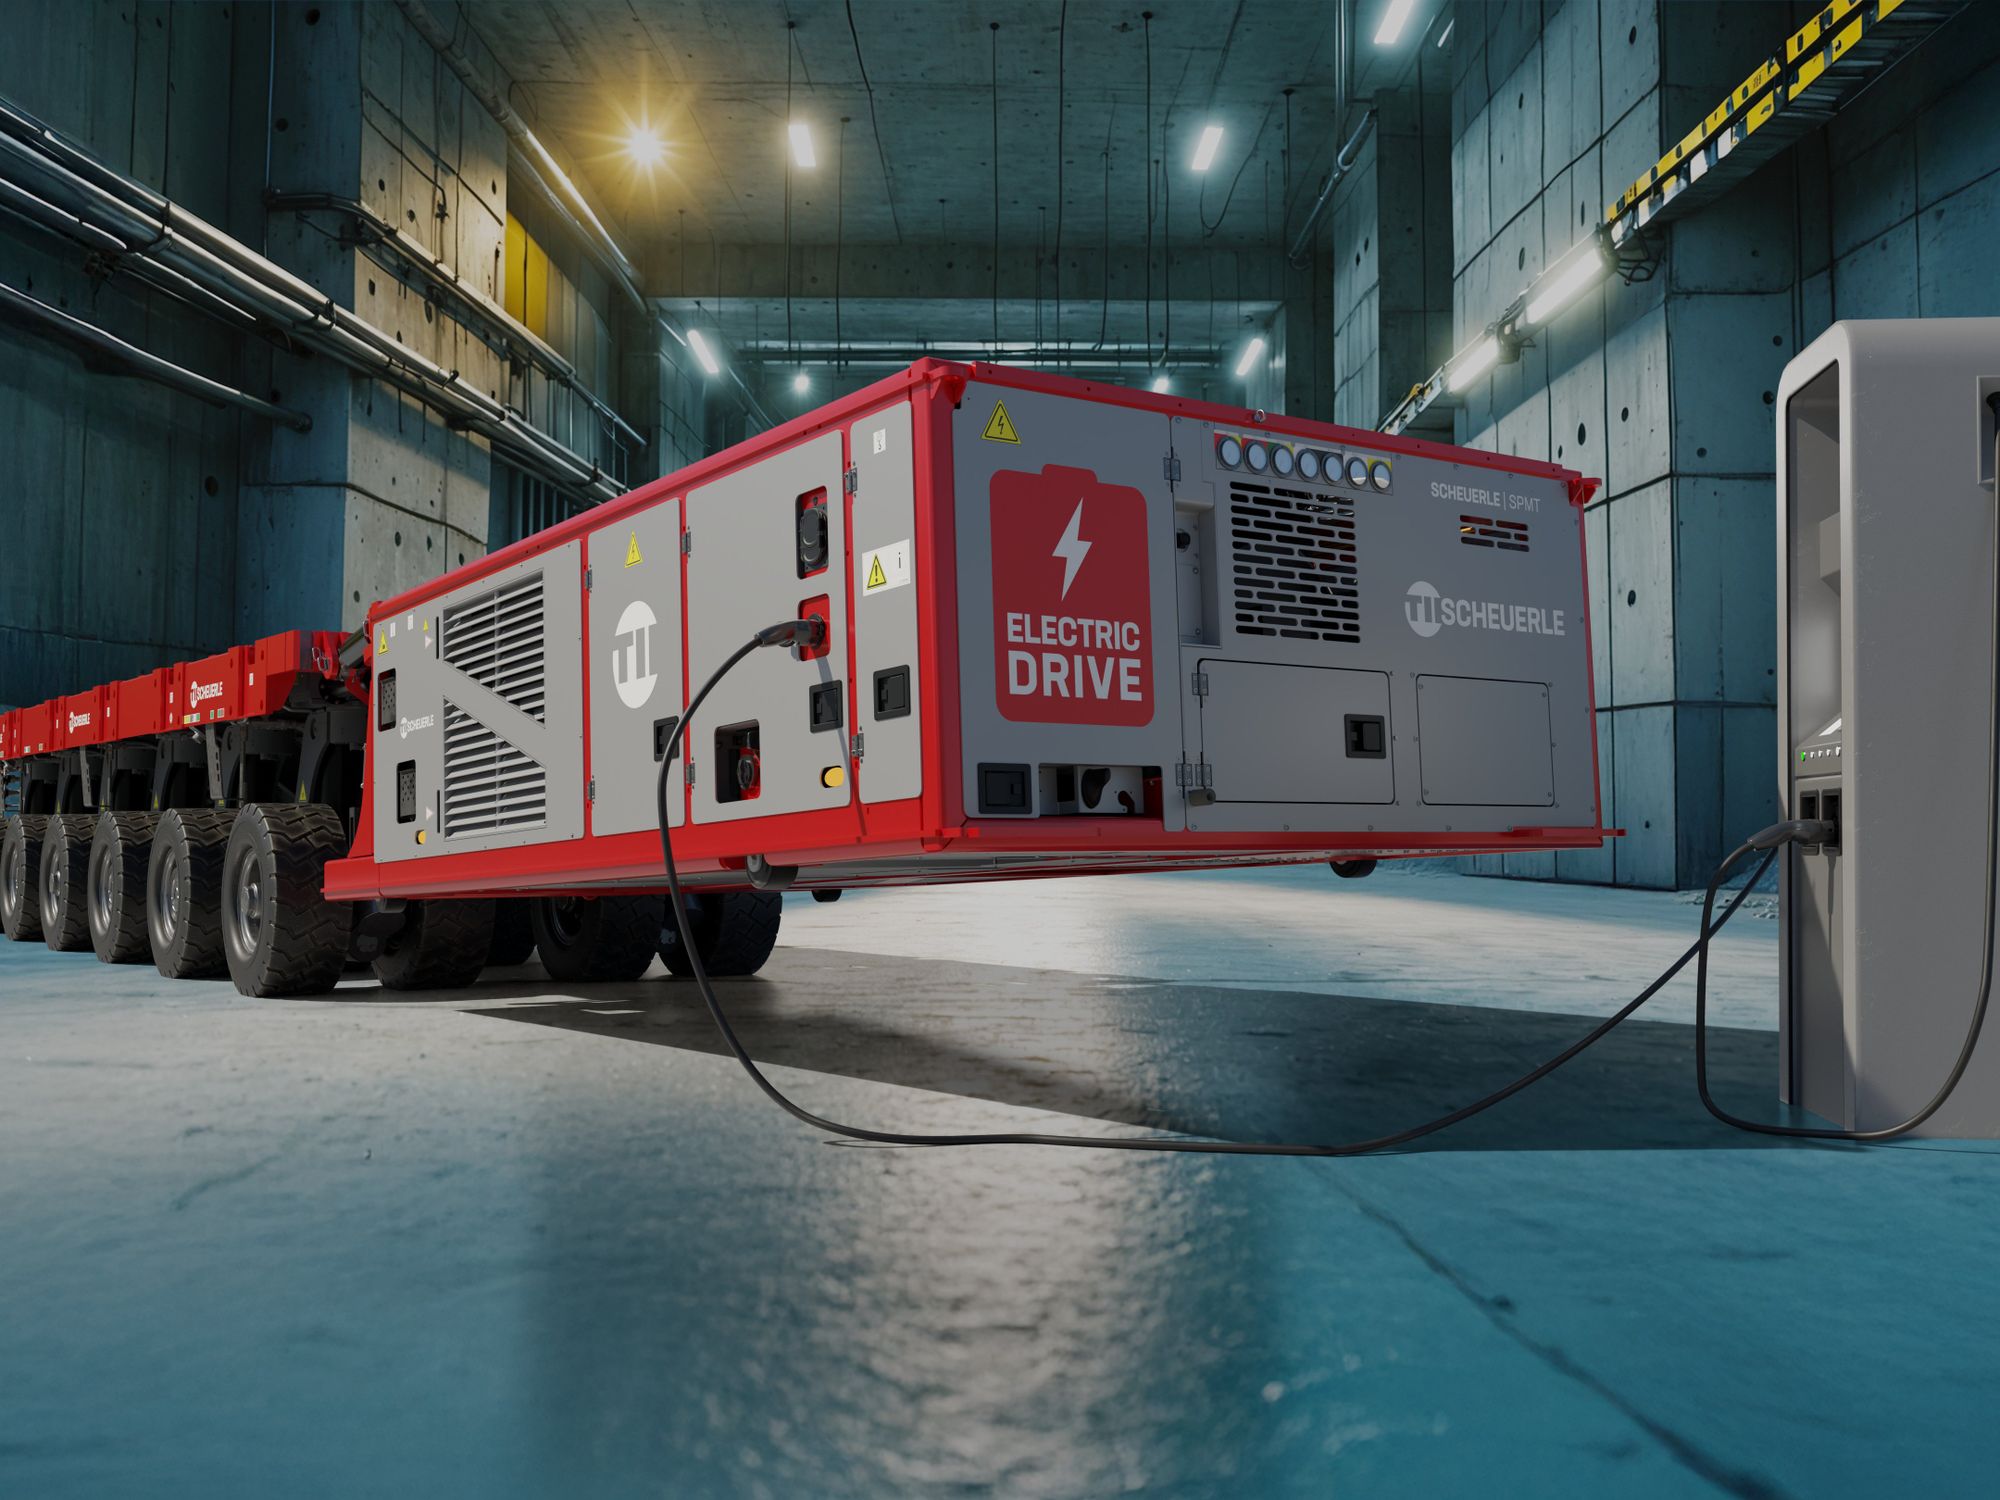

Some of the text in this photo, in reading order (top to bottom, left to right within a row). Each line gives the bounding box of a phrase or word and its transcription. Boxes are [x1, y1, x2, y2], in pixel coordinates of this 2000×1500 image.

[1430, 482, 1541, 513] SCHEUERLE SPMT
[1007, 612, 1141, 651] ELECTRIC
[1441, 598, 1566, 636] SCHEUERLE
[1008, 650, 1142, 702] DRIVE
